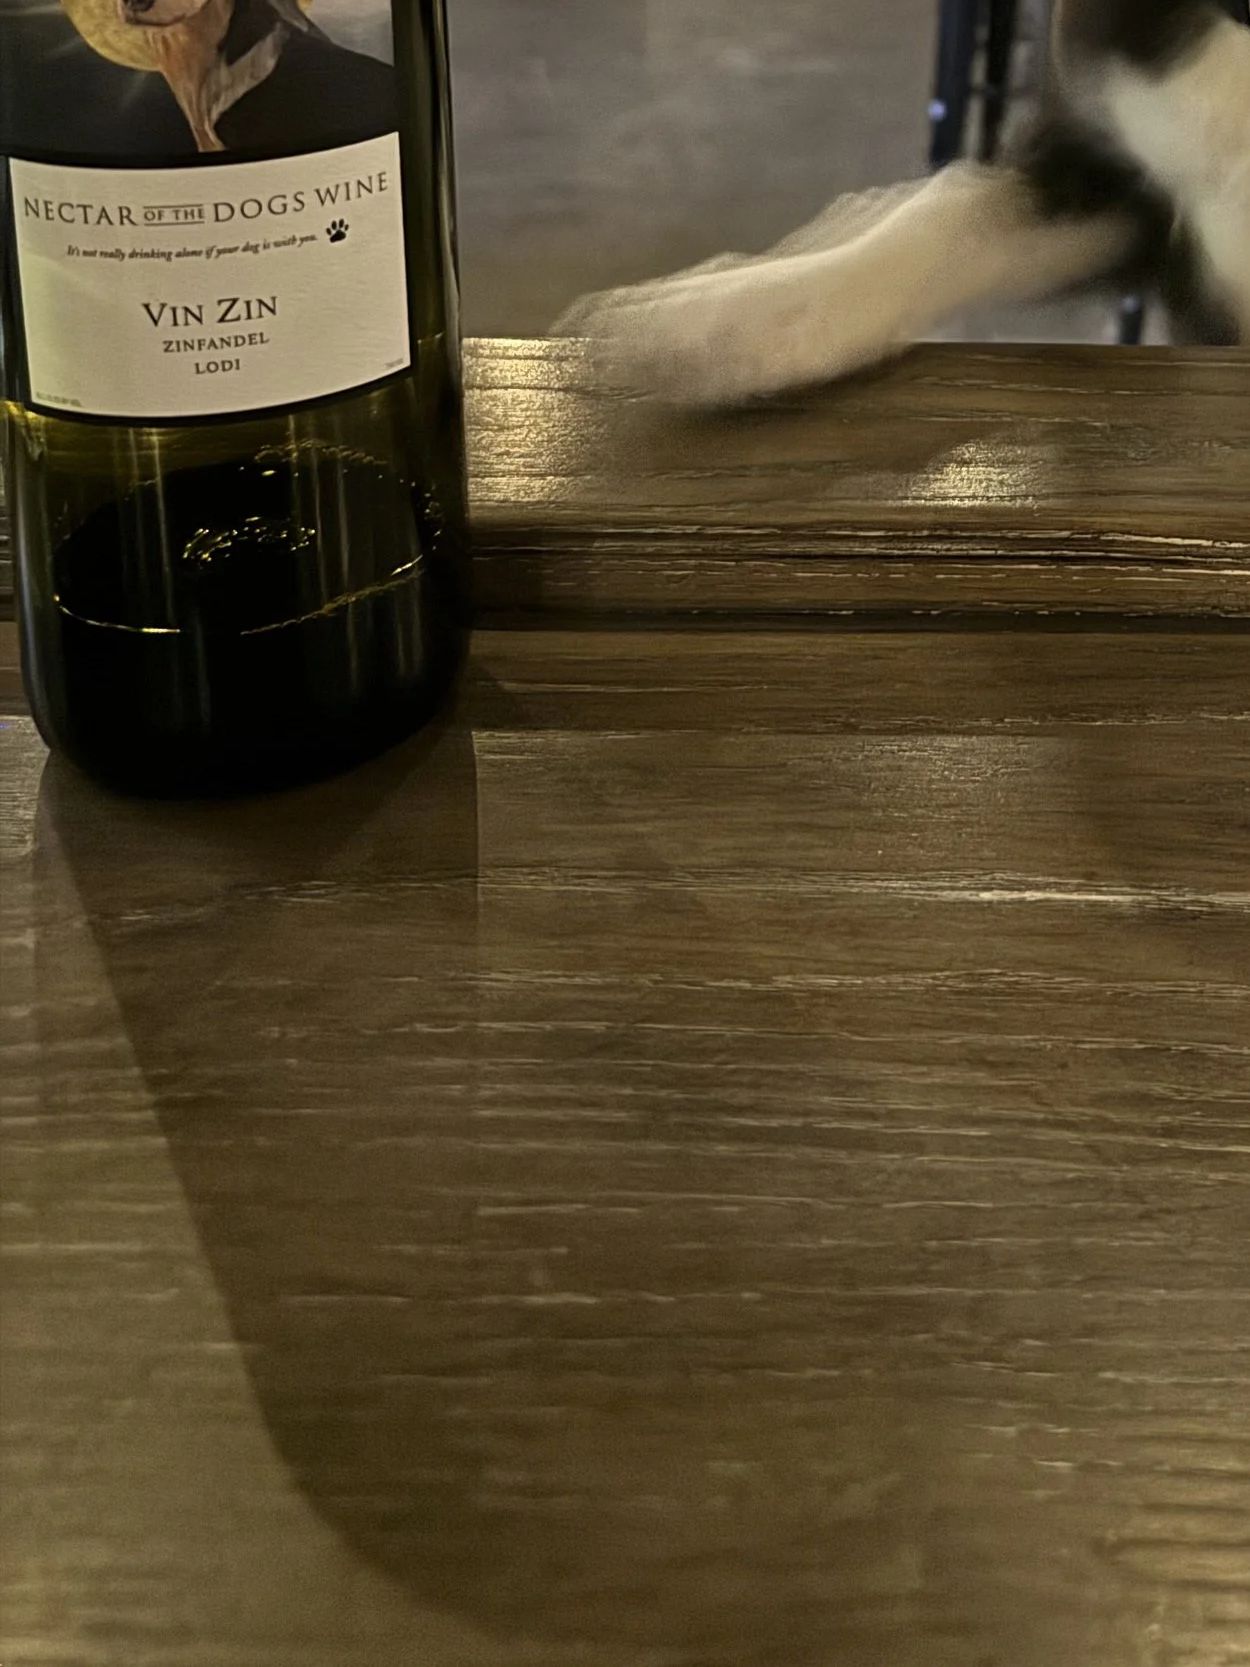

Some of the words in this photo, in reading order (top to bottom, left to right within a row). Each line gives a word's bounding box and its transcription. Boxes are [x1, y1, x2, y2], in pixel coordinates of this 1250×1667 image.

[24, 196, 138, 227] NECTAR
[144, 209, 165, 222] OF
[170, 207, 205, 221] THE
[213, 191, 305, 223] DOGS
[313, 171, 388, 207] WINE
[67, 243, 80, 257] It's
[82, 248, 98, 258] not
[99, 247, 126, 263] really
[127, 247, 173, 263] drinking
[174, 246, 203, 258] alone
[205, 244, 217, 260] if
[214, 245, 240, 260] your
[241, 240, 260, 255] dog
[262, 238, 271, 251] is
[273, 233, 297, 248] with
[141, 301, 204, 327] VIN
[216, 295, 278, 324] ZIN
[162, 331, 270, 354] ZINFANDEL
[194, 357, 241, 375] LODI
